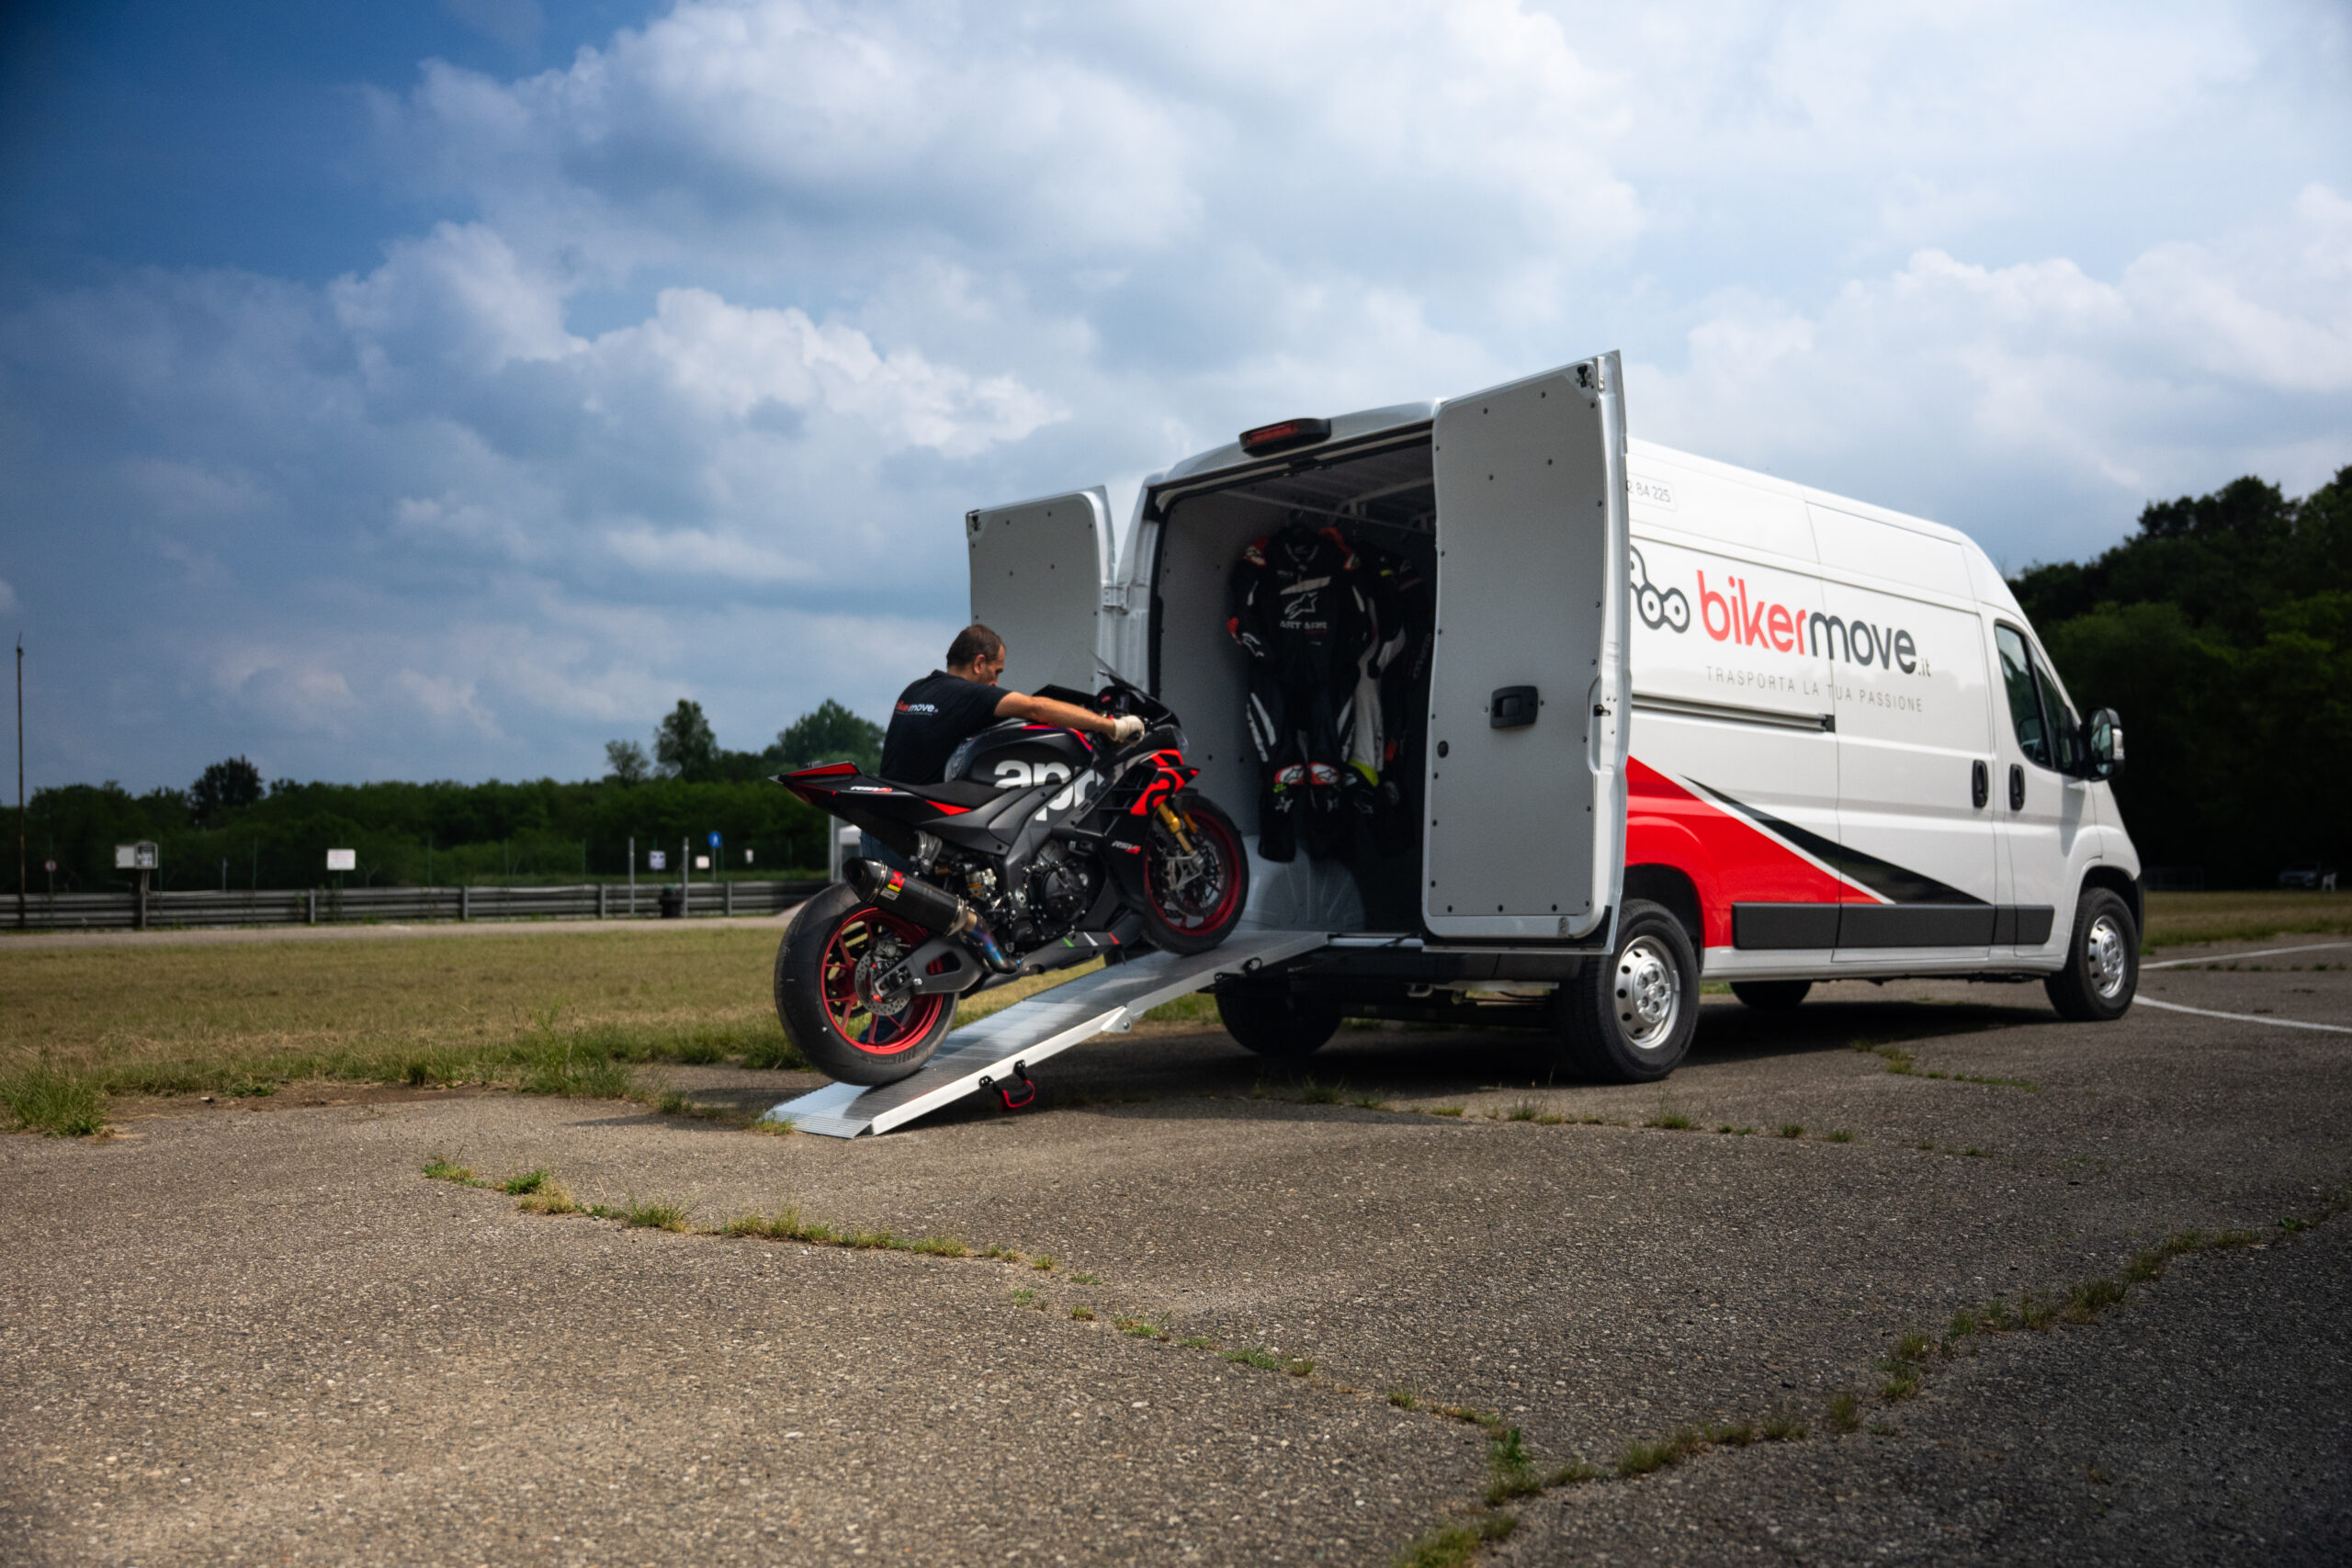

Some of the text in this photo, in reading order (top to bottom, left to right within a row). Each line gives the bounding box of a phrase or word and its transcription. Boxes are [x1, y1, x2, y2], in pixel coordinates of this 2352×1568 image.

[1653, 486, 1670, 502] 225
[1706, 666, 1923, 713] TRASPORTA LA TUA PASSIONE
[994, 760, 1105, 821] apr
